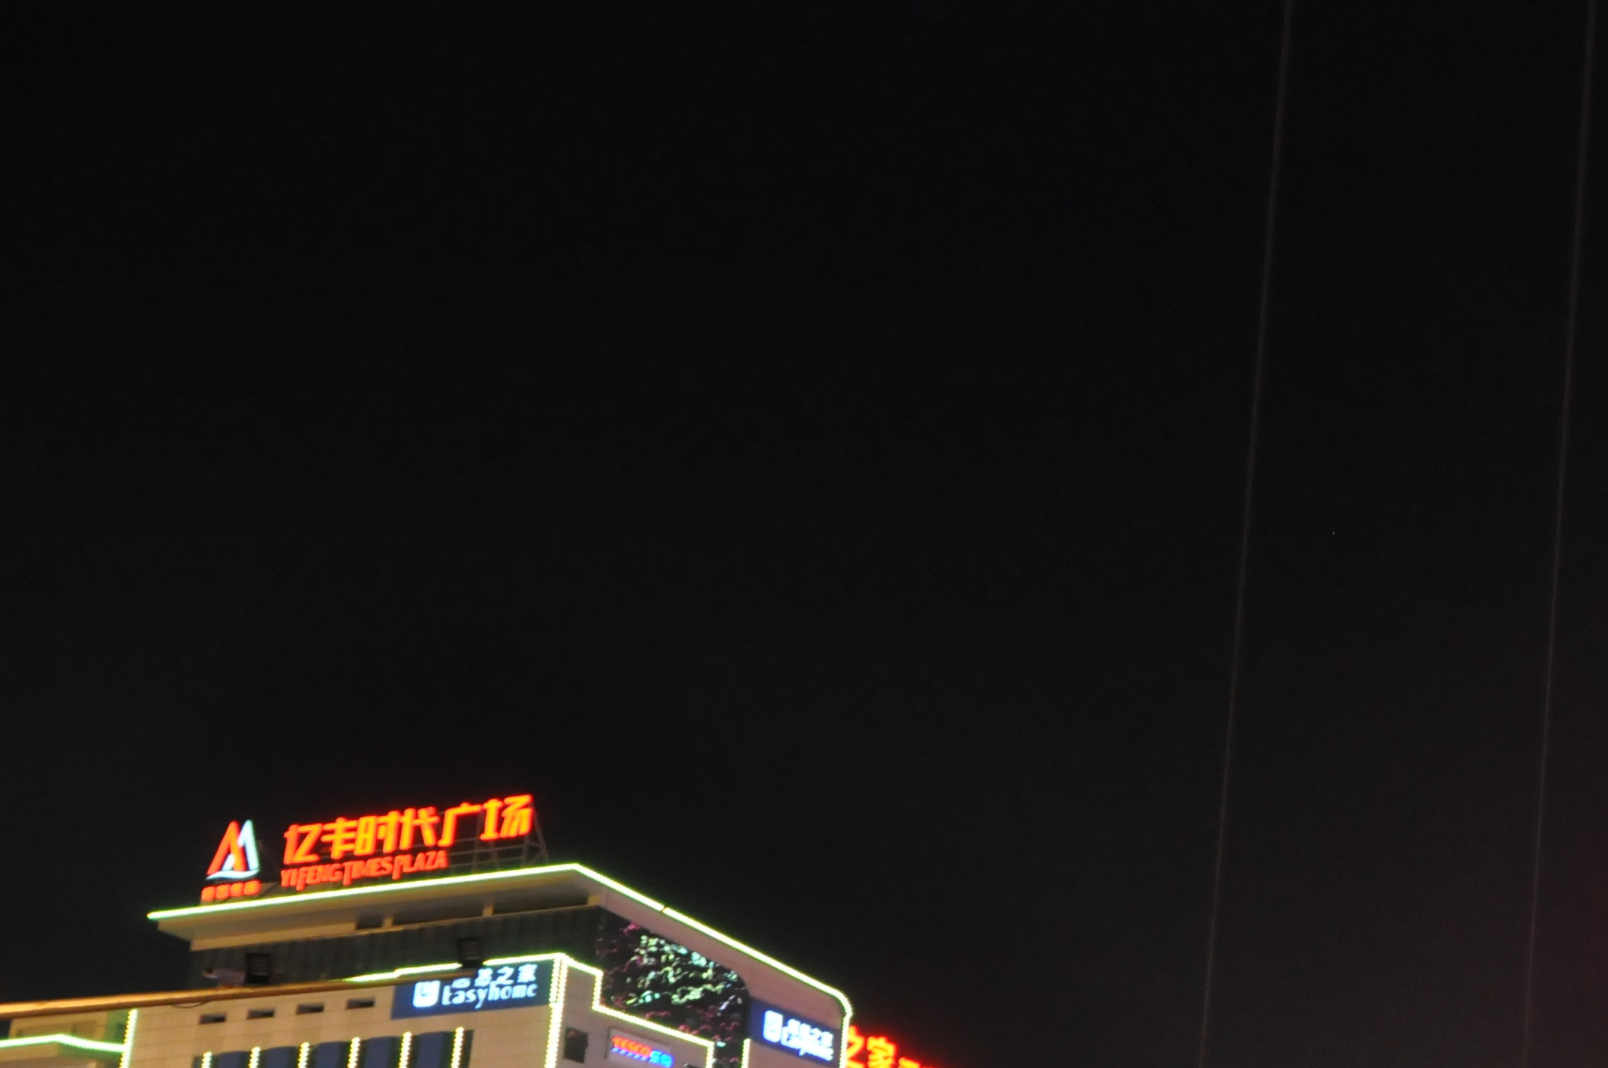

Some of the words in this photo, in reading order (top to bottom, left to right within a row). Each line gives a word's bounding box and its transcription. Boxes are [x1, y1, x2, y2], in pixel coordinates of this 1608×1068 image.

[283, 794, 533, 865] 亿丰时代广场
[342, 856, 393, 886] TIMES
[391, 850, 448, 880] PLAZA
